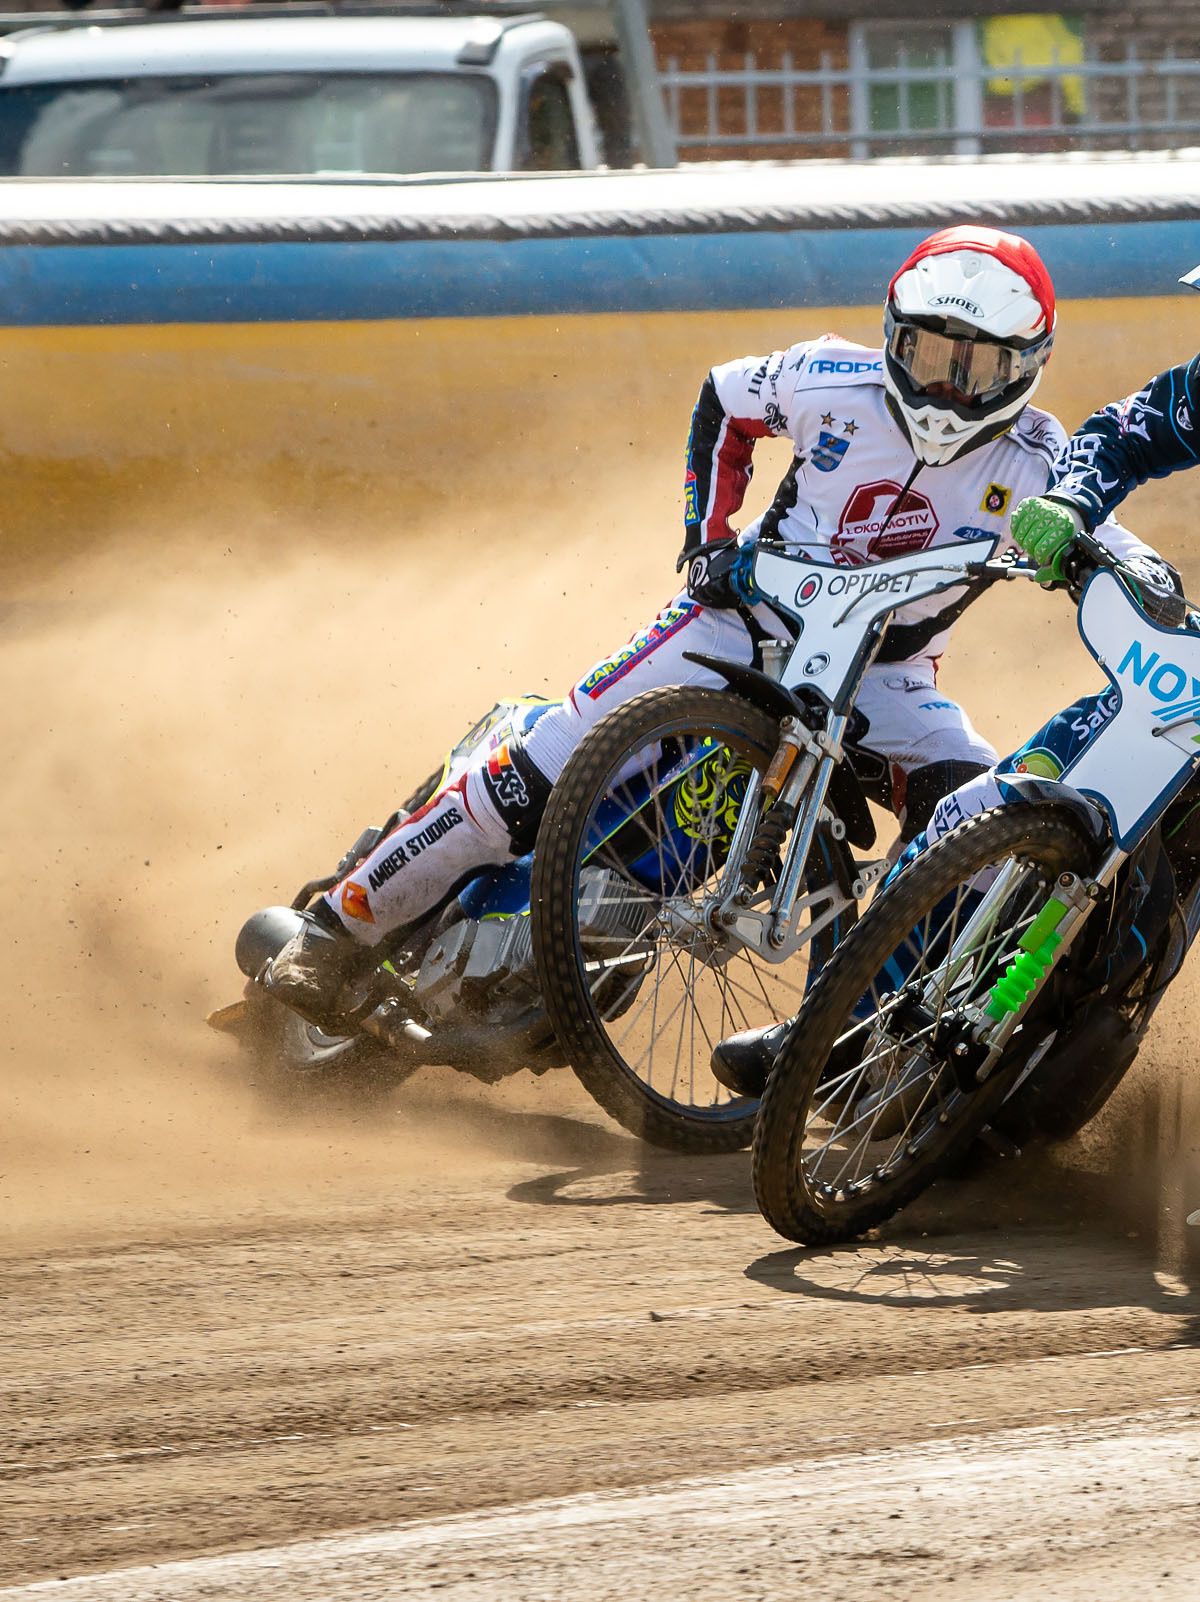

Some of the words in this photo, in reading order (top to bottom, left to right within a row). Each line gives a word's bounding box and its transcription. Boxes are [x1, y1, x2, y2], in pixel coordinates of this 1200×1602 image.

[935, 296, 978, 315] SHOEI
[845, 513, 930, 535] LOKOMOTIV
[827, 572, 919, 596] OPTIBET
[368, 845, 412, 893] AMBER
[405, 807, 464, 857] STUDIOS
